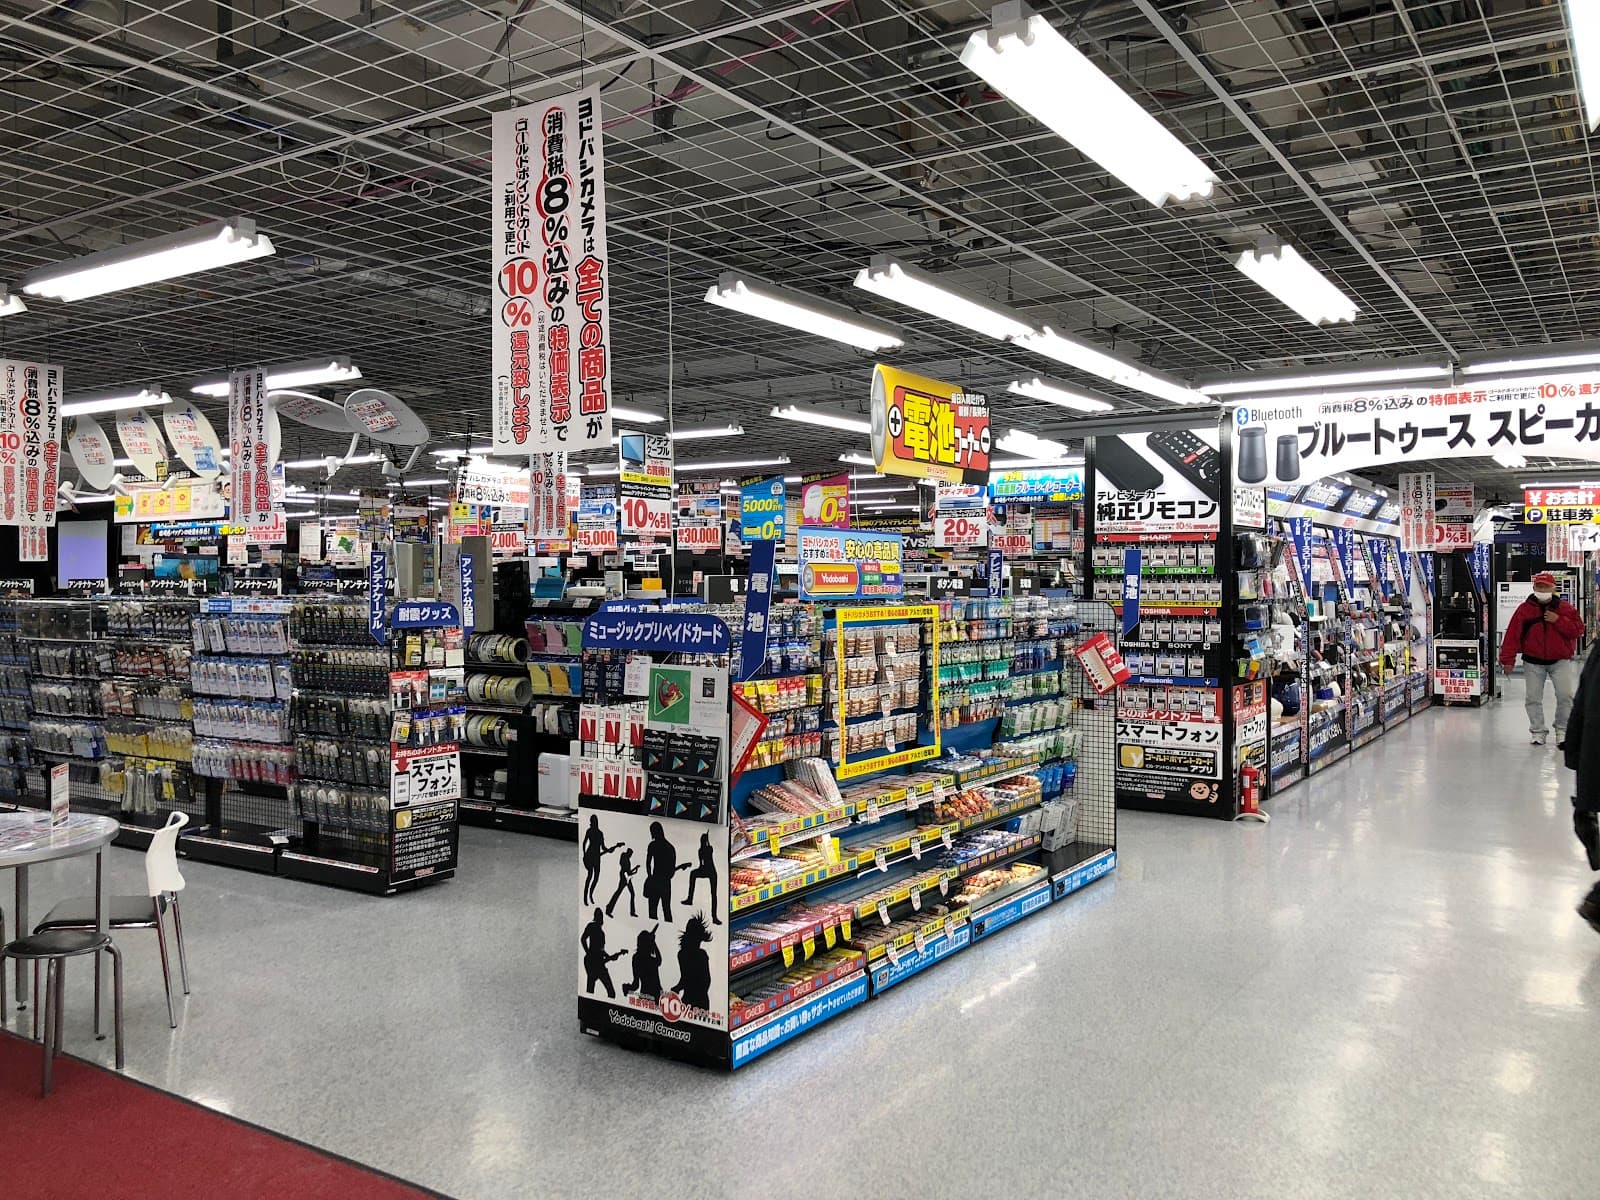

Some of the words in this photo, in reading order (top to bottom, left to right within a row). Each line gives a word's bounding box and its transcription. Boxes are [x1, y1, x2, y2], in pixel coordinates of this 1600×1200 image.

[517, 118, 530, 253] ゴールドポイントカード
[504, 181, 516, 256] ご利用で更に
[576, 97, 606, 438] ヨドバシカメラは全ての商品が
[544, 112, 571, 441] 消費税8%込みの特価表示で
[1251, 406, 1302, 422] Bluetooth
[1297, 413, 1476, 459] ブルートゥース
[1097, 490, 1166, 501] テレビメーカー
[624, 498, 671, 530] 10%引
[1096, 500, 1218, 522] 純正リモコン
[1546, 508, 1594, 521] 駐車券
[943, 518, 980, 537] 20%
[68, 580, 105, 588] アンテナケーブル
[150, 580, 188, 589] アンテナケーブル
[234, 580, 279, 589] アンテナケーブル
[821, 573, 849, 583] Yodobashi
[371, 554, 385, 630] アンテナケーブル
[1139, 676, 1174, 684] Panasonic
[644, 735, 657, 743] Google
[1117, 723, 1219, 743] スマートフォン
[669, 739, 684, 747] Google
[684, 740, 692, 748] Play
[412, 760, 456, 778] スマート
[1190, 765, 1213, 774] アプリ
[673, 783, 686, 791] Google
[609, 1009, 655, 1033] Yodobashi
[655, 1021, 691, 1043] Camera
